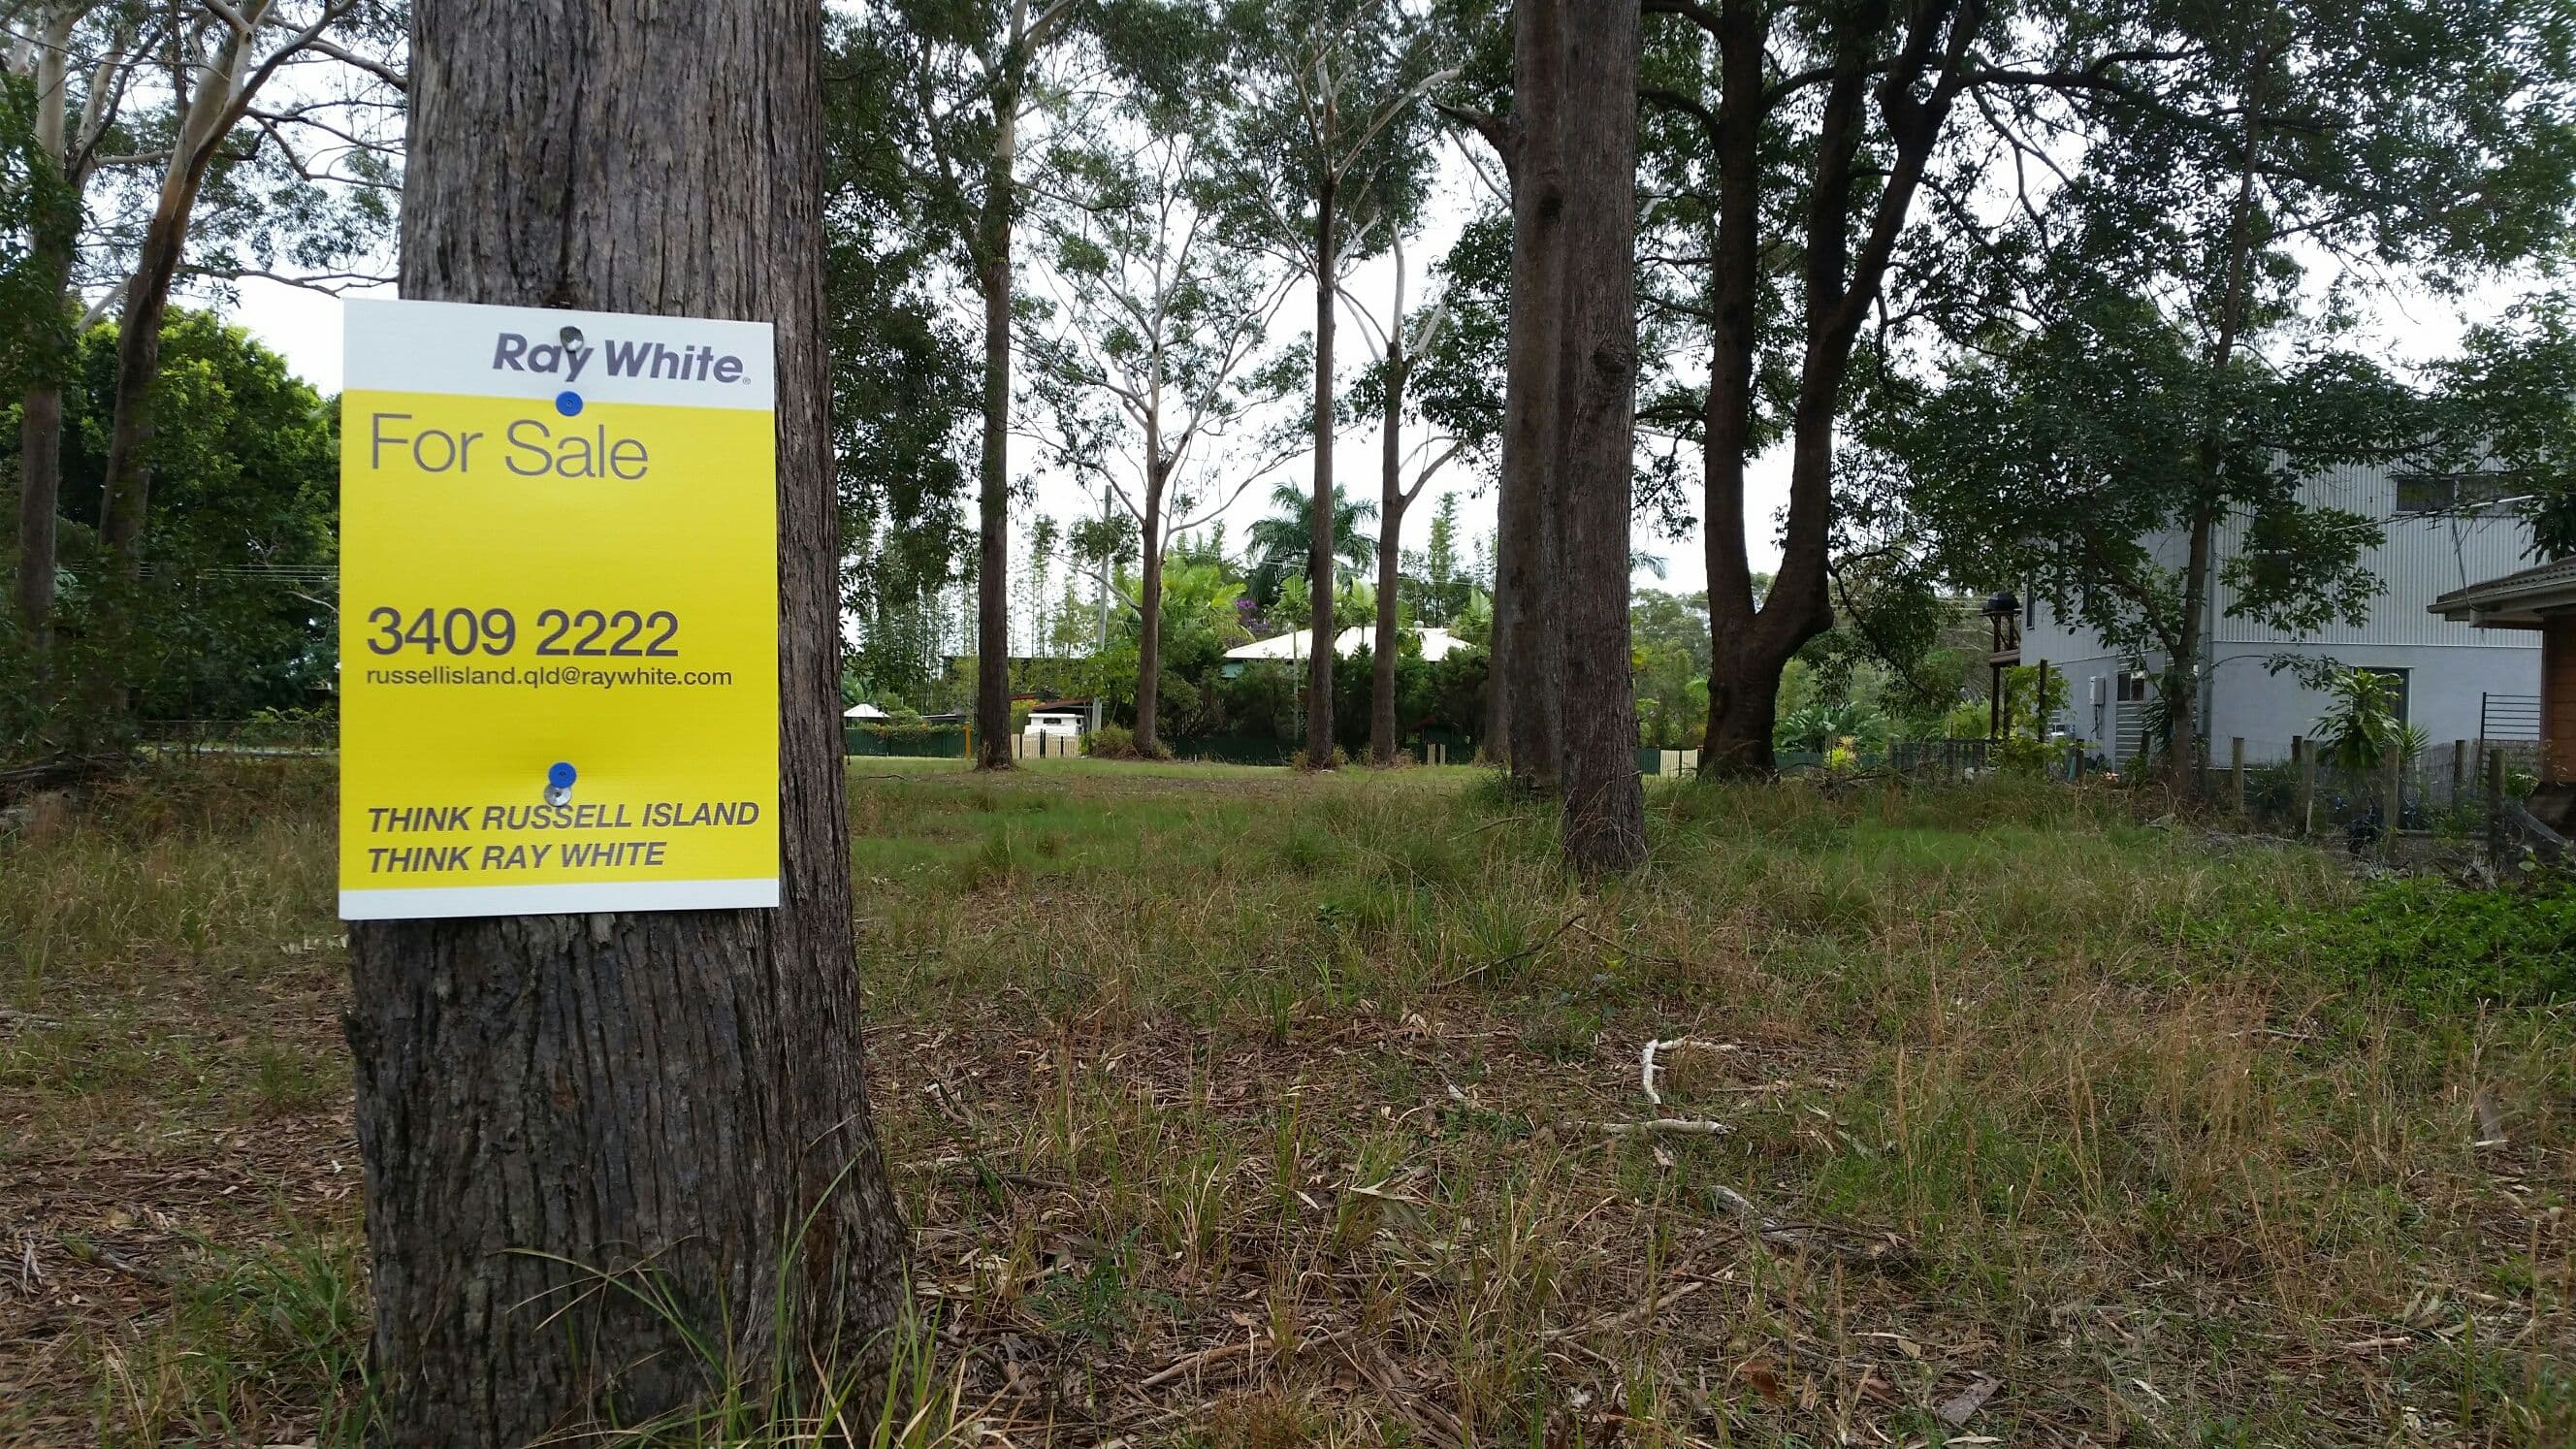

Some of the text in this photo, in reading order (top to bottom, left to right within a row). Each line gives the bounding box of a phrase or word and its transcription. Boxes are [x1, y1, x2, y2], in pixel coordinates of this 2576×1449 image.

[492, 332, 594, 382] Ray
[371, 412, 649, 480] For Sale
[367, 607, 679, 657] 3409 2222
[367, 666, 733, 689] russellisland.qld@raywhite.com
[368, 801, 760, 832] THINK RUSSELL ISLAND
[368, 841, 667, 873] THINK RAY WHITE
